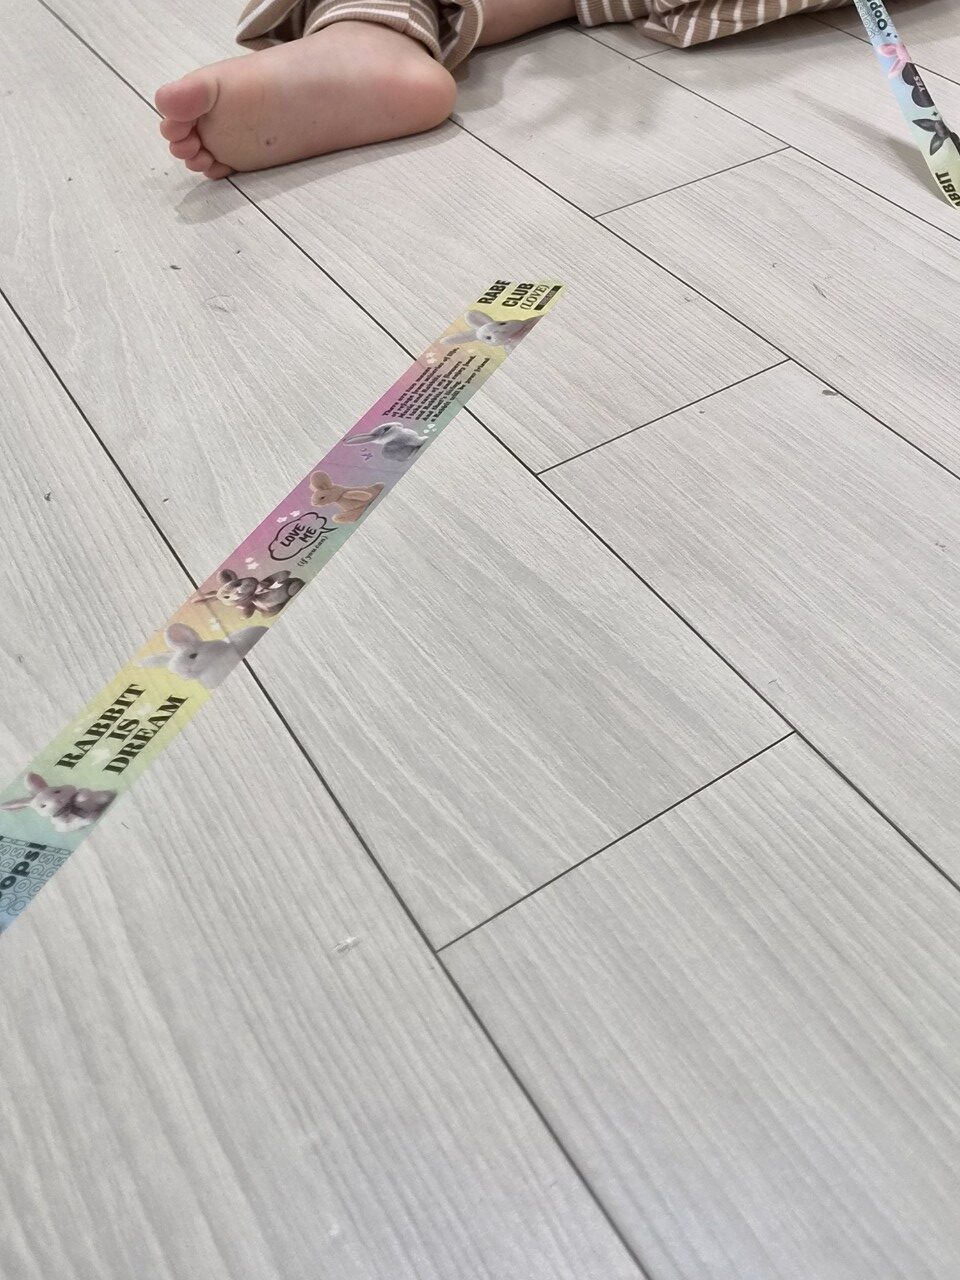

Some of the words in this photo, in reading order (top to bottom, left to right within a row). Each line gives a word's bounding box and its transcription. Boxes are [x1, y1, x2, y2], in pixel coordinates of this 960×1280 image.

[501, 283, 534, 307] CLUB
[519, 284, 550, 310] (LOVE)
[280, 523, 305, 547] LOVE
[299, 526, 317, 543] ME
[54, 683, 147, 770] RABBIT
[101, 694, 189, 775] DREAM
[106, 718, 140, 742] IS
[0, 842, 47, 900] ops!
